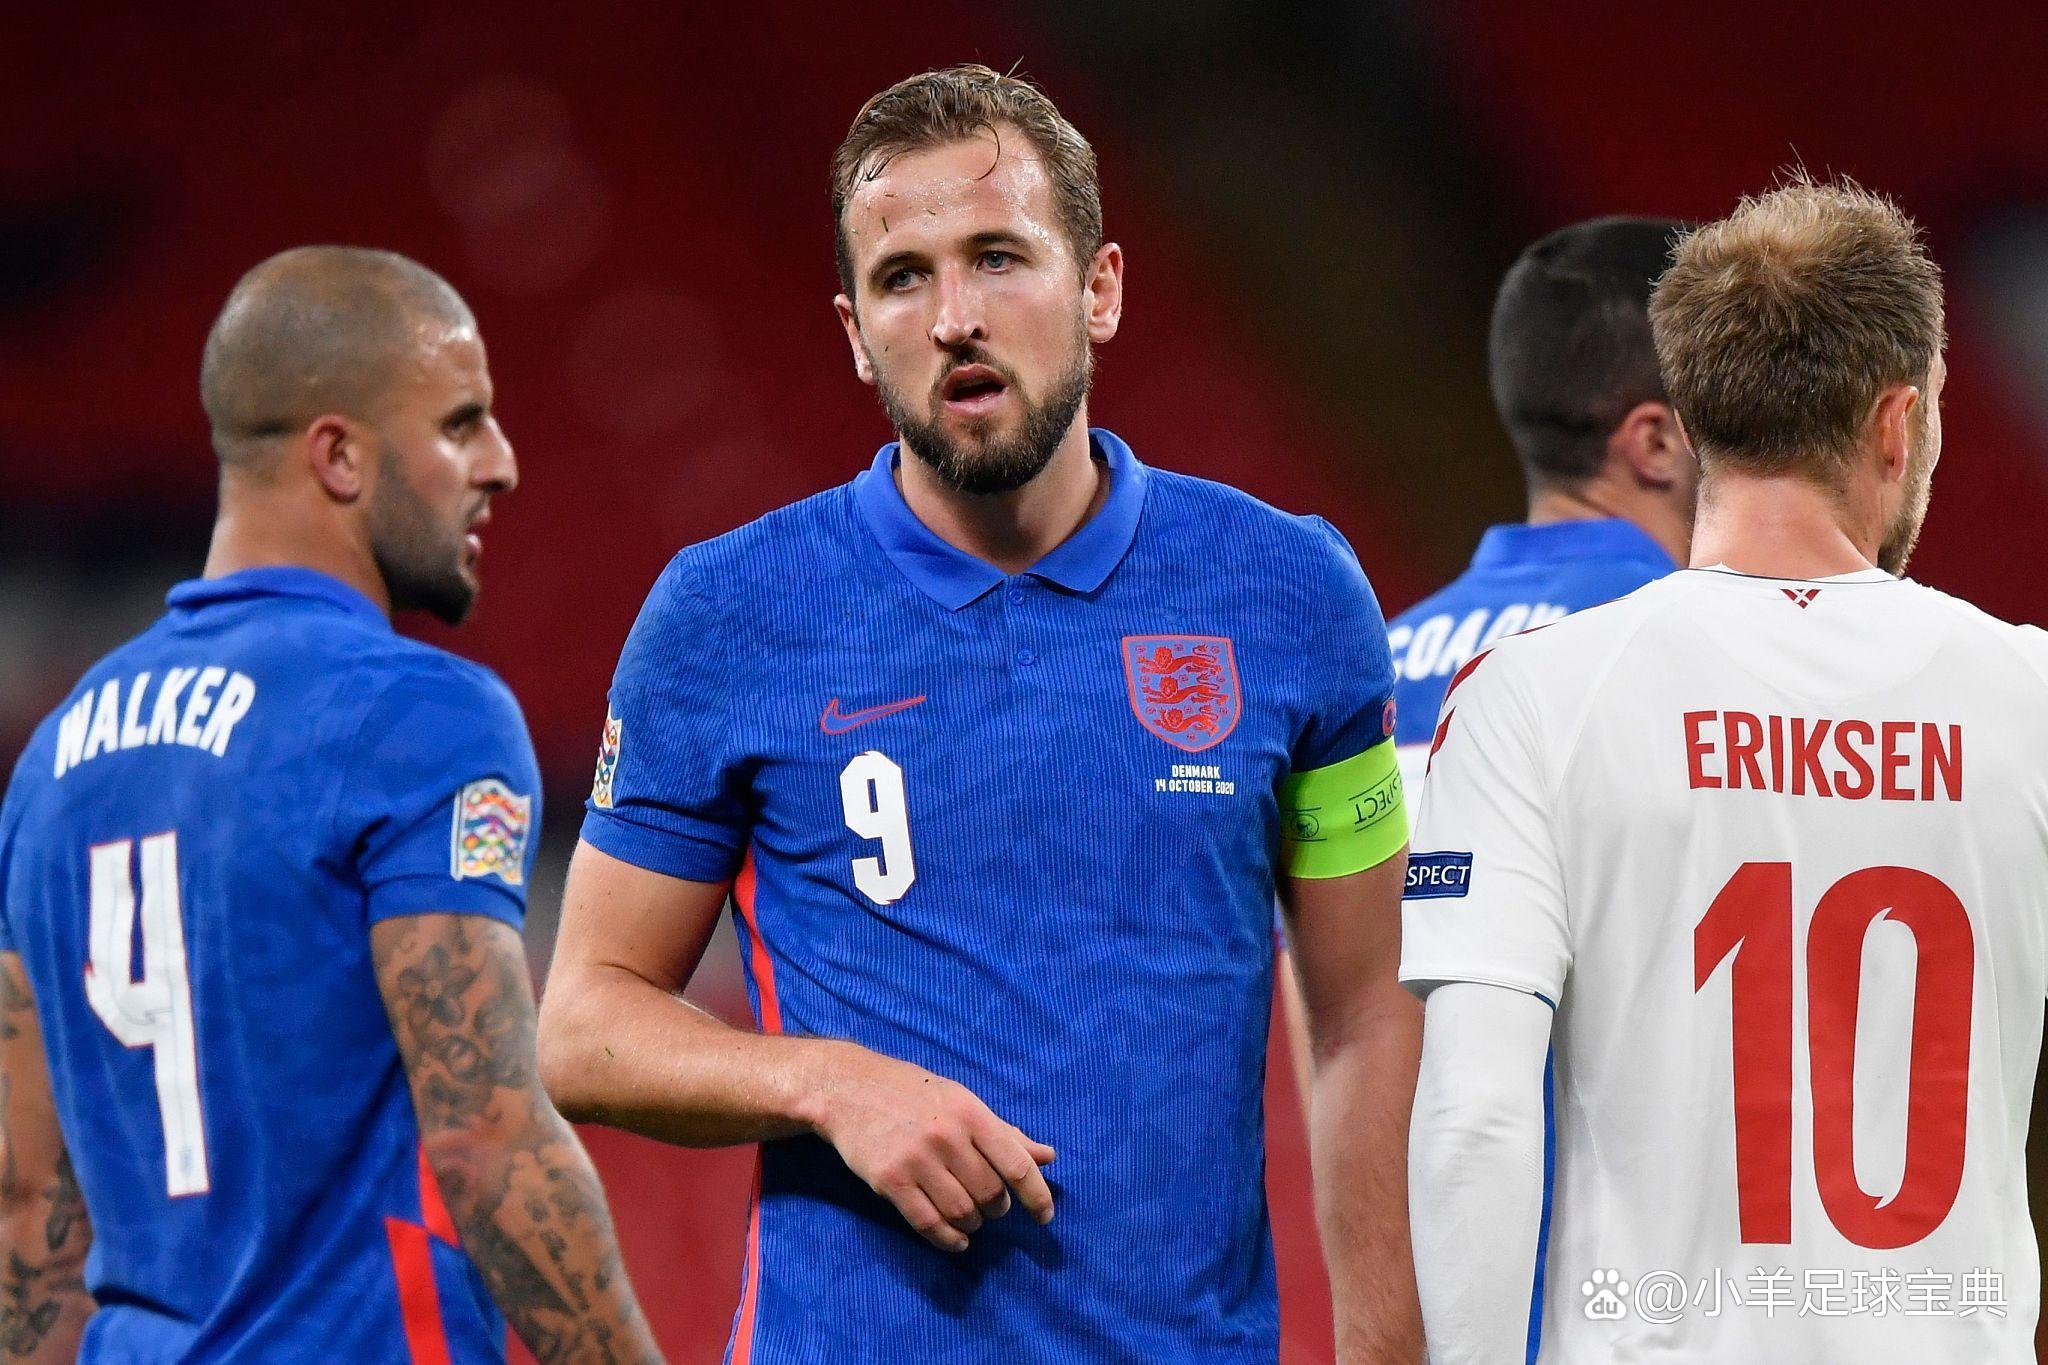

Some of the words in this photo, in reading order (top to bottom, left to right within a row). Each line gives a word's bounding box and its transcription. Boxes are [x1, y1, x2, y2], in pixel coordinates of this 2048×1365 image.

[54, 666, 256, 779] WALKER
[1171, 765, 1220, 779] DENMARK
[1684, 710, 1962, 801] ERIKSEN
[839, 750, 915, 905] 9
[1155, 779, 1166, 792] 14
[1168, 779, 1213, 793] OCTOBER
[1215, 781, 1235, 795] 2020
[1406, 865, 1470, 886] SPECT
[84, 830, 210, 1197] 4
[1693, 861, 1974, 1249] 10
